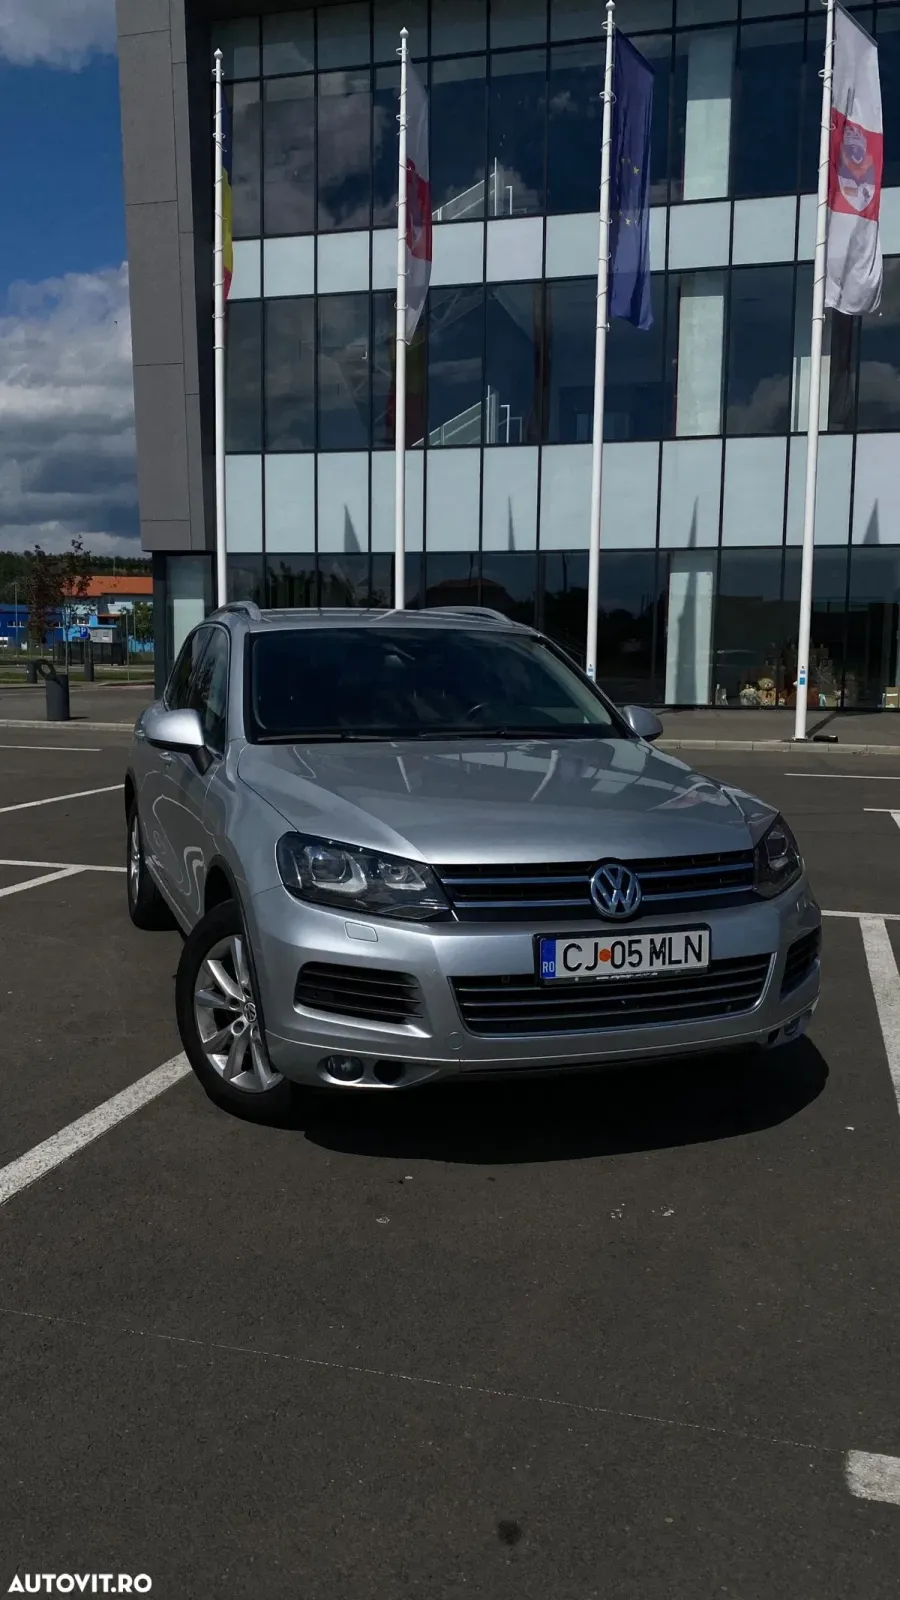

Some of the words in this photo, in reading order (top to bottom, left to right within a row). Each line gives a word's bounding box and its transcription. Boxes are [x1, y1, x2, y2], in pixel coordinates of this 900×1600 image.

[80, 627, 87, 635] P
[562, 942, 599, 972] CJ
[610, 939, 643, 969] 05
[649, 934, 703, 967] MLN
[542, 960, 555, 973] RO
